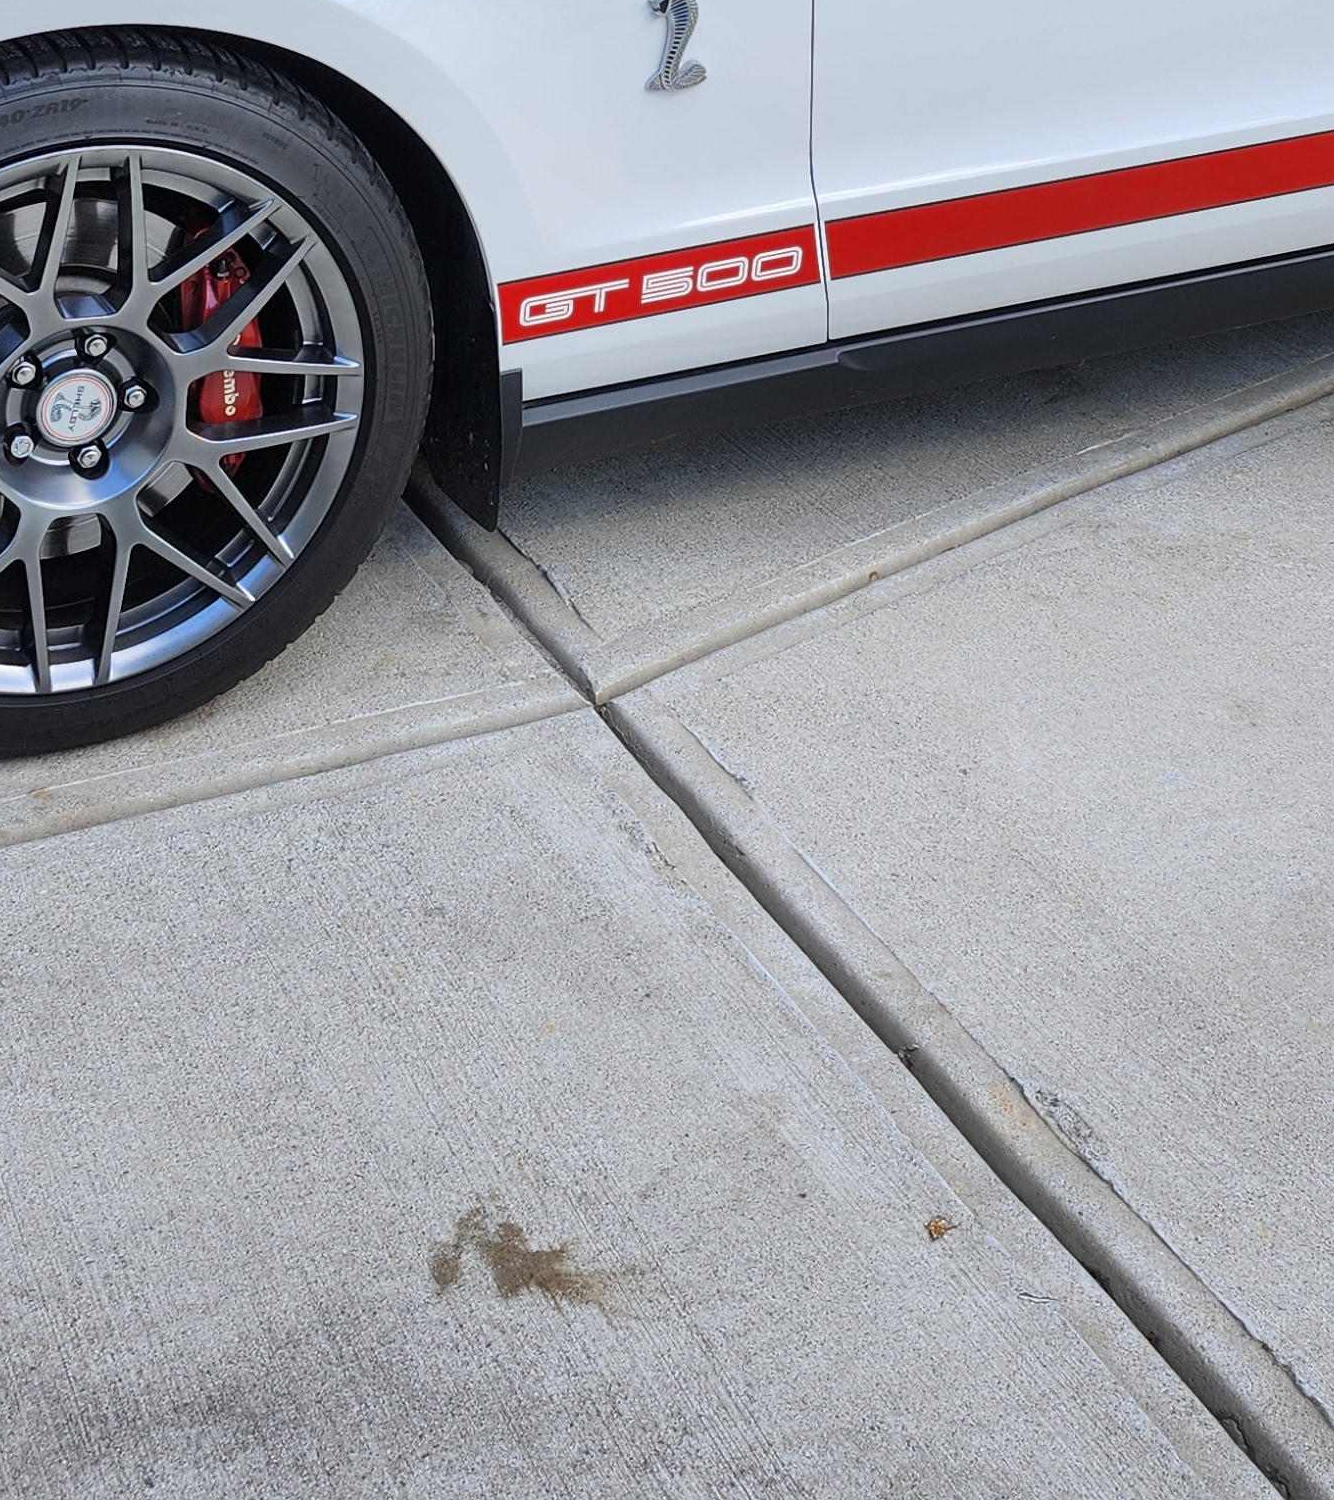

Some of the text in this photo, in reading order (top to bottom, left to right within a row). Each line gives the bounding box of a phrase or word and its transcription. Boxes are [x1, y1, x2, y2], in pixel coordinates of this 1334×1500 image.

[519, 245, 804, 328] GT 500
[67, 385, 85, 432] SHELBY
